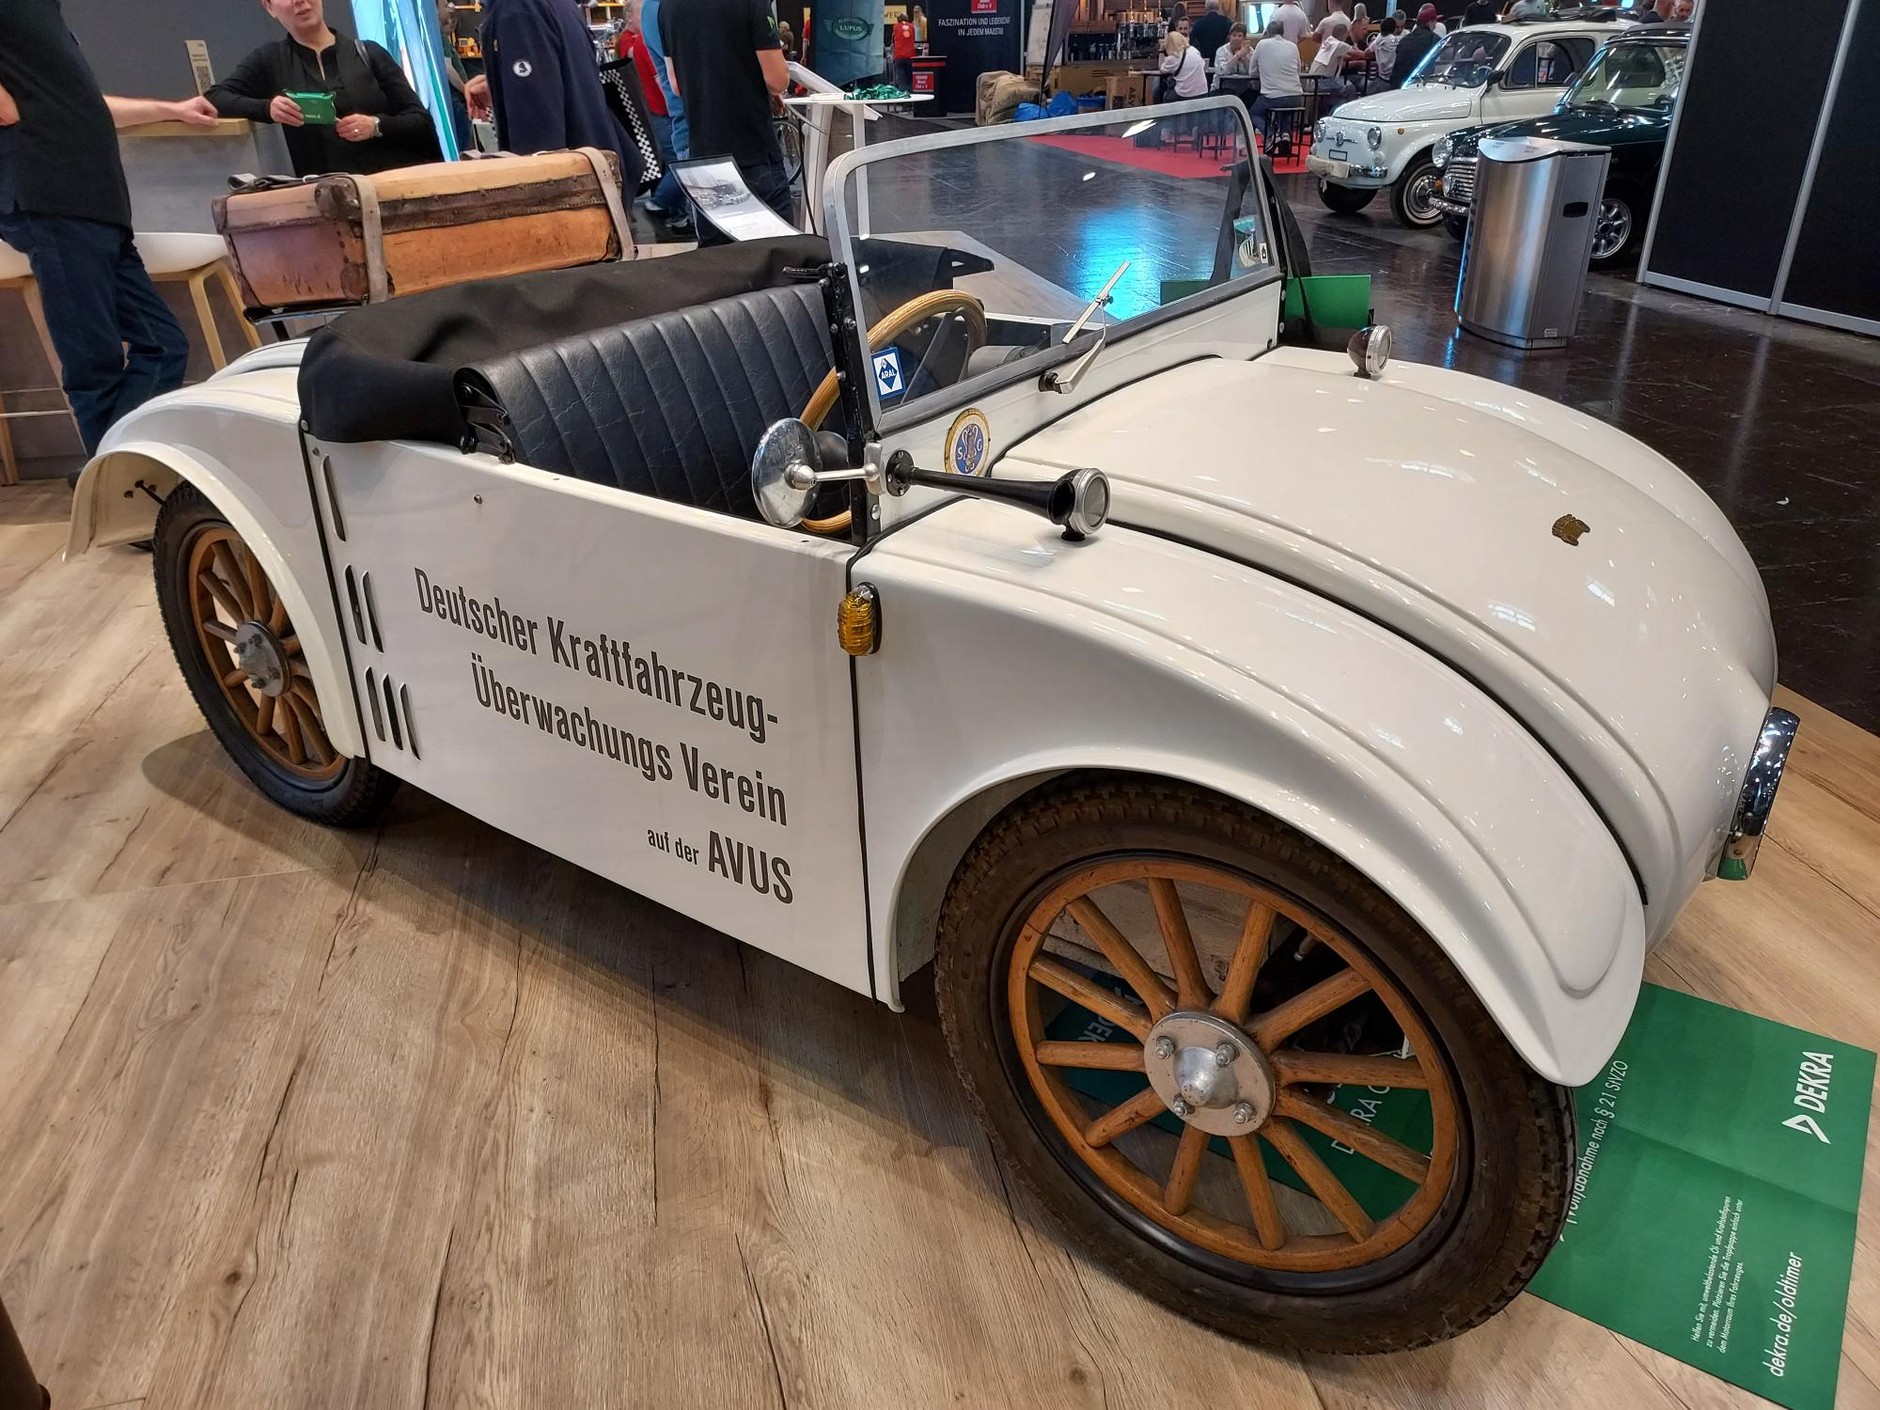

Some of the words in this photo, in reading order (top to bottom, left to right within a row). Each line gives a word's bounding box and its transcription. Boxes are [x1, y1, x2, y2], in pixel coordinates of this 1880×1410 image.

[938, 18, 977, 26] FASZINATION
[978, 17, 988, 25] UND
[881, 369, 896, 379] ARAL
[414, 567, 538, 655] Deutscher
[546, 616, 778, 744] Kraftfahrzeug-
[471, 652, 673, 782] Überwachungs
[680, 742, 787, 826] Verein
[647, 829, 670, 853] auf
[675, 838, 699, 865] der
[708, 830, 793, 904] AVUS
[1605, 1060, 1629, 1092] StVZO
[1793, 1050, 1834, 1114] DEKRA
[1599, 1091, 1617, 1108] 21
[1594, 1107, 1615, 1119] §
[1590, 1118, 1608, 1141] nach
[1730, 1212, 1740, 1231] einfach
[1714, 1233, 1722, 1245] und
[1718, 1271, 1728, 1280] Sie
[1721, 1262, 1730, 1271] die
[1702, 1254, 1718, 1301] umweltbelastende
[1729, 1261, 1744, 1293] Fahrzeuges.
[1712, 1280, 1725, 1308] Platzieren
[1726, 1294, 1737, 1308] Ihres
[1695, 1312, 1705, 1323] Sie
[1708, 1309, 1720, 1339] vermeiden.
[1720, 1308, 1734, 1340] Motorraum
[1762, 1251, 1802, 1377] dekra.de/oldtimer
[1690, 1322, 1702, 1342] Helfen
[1706, 1339, 1713, 1348] zu
[1716, 1340, 1727, 1354] dem
